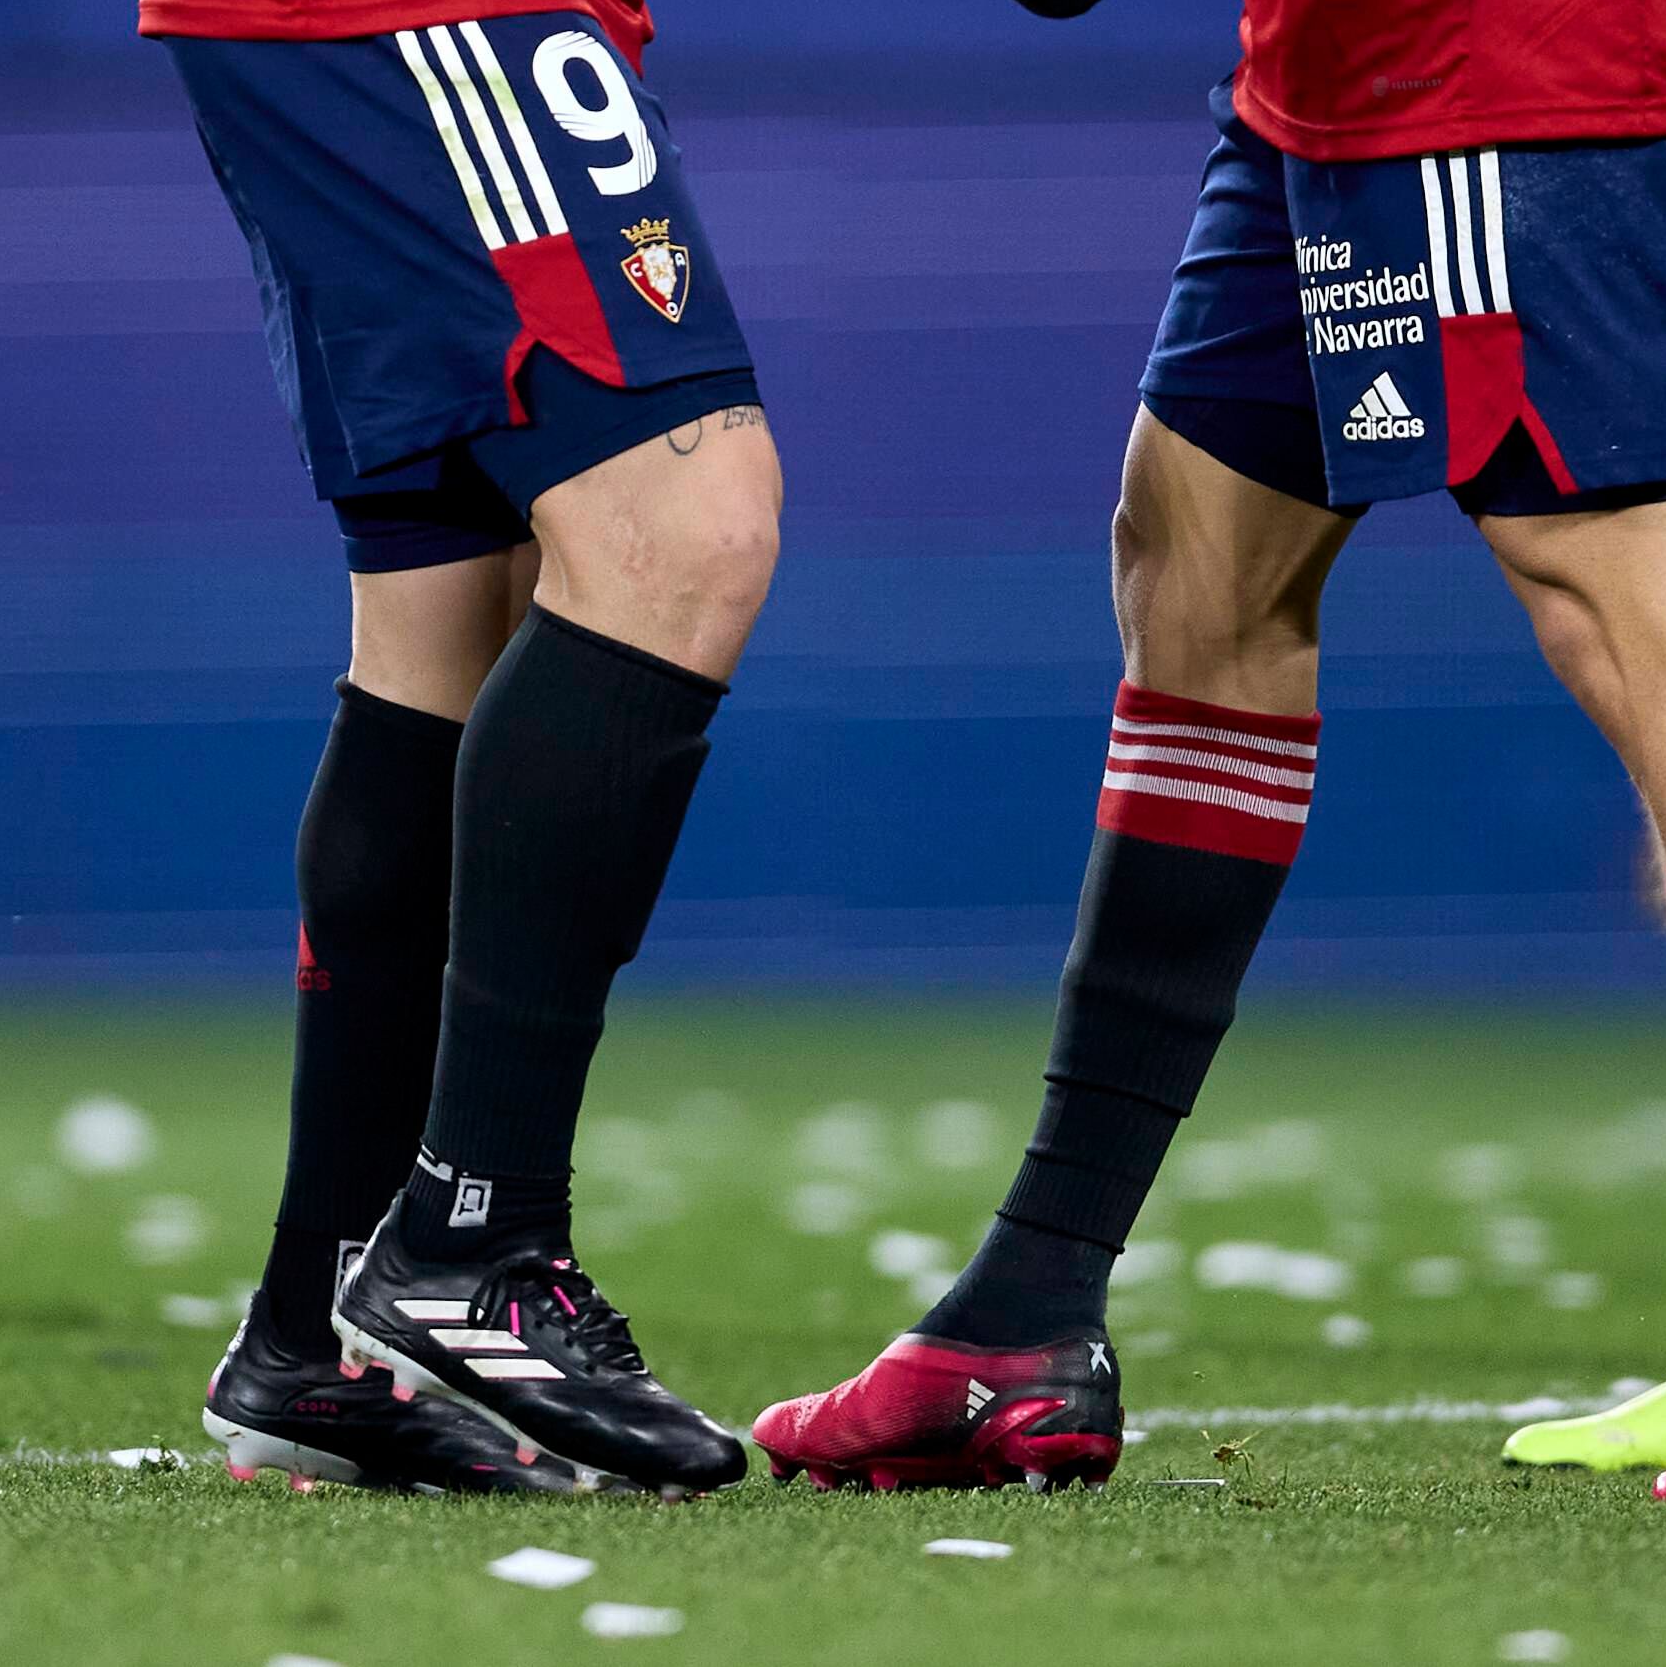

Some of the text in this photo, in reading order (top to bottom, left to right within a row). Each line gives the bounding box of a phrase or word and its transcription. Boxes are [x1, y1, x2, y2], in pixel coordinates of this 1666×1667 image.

[532, 30, 658, 197] 9
[1313, 315, 1425, 356] Navarra
[1342, 414, 1426, 442] adidas
